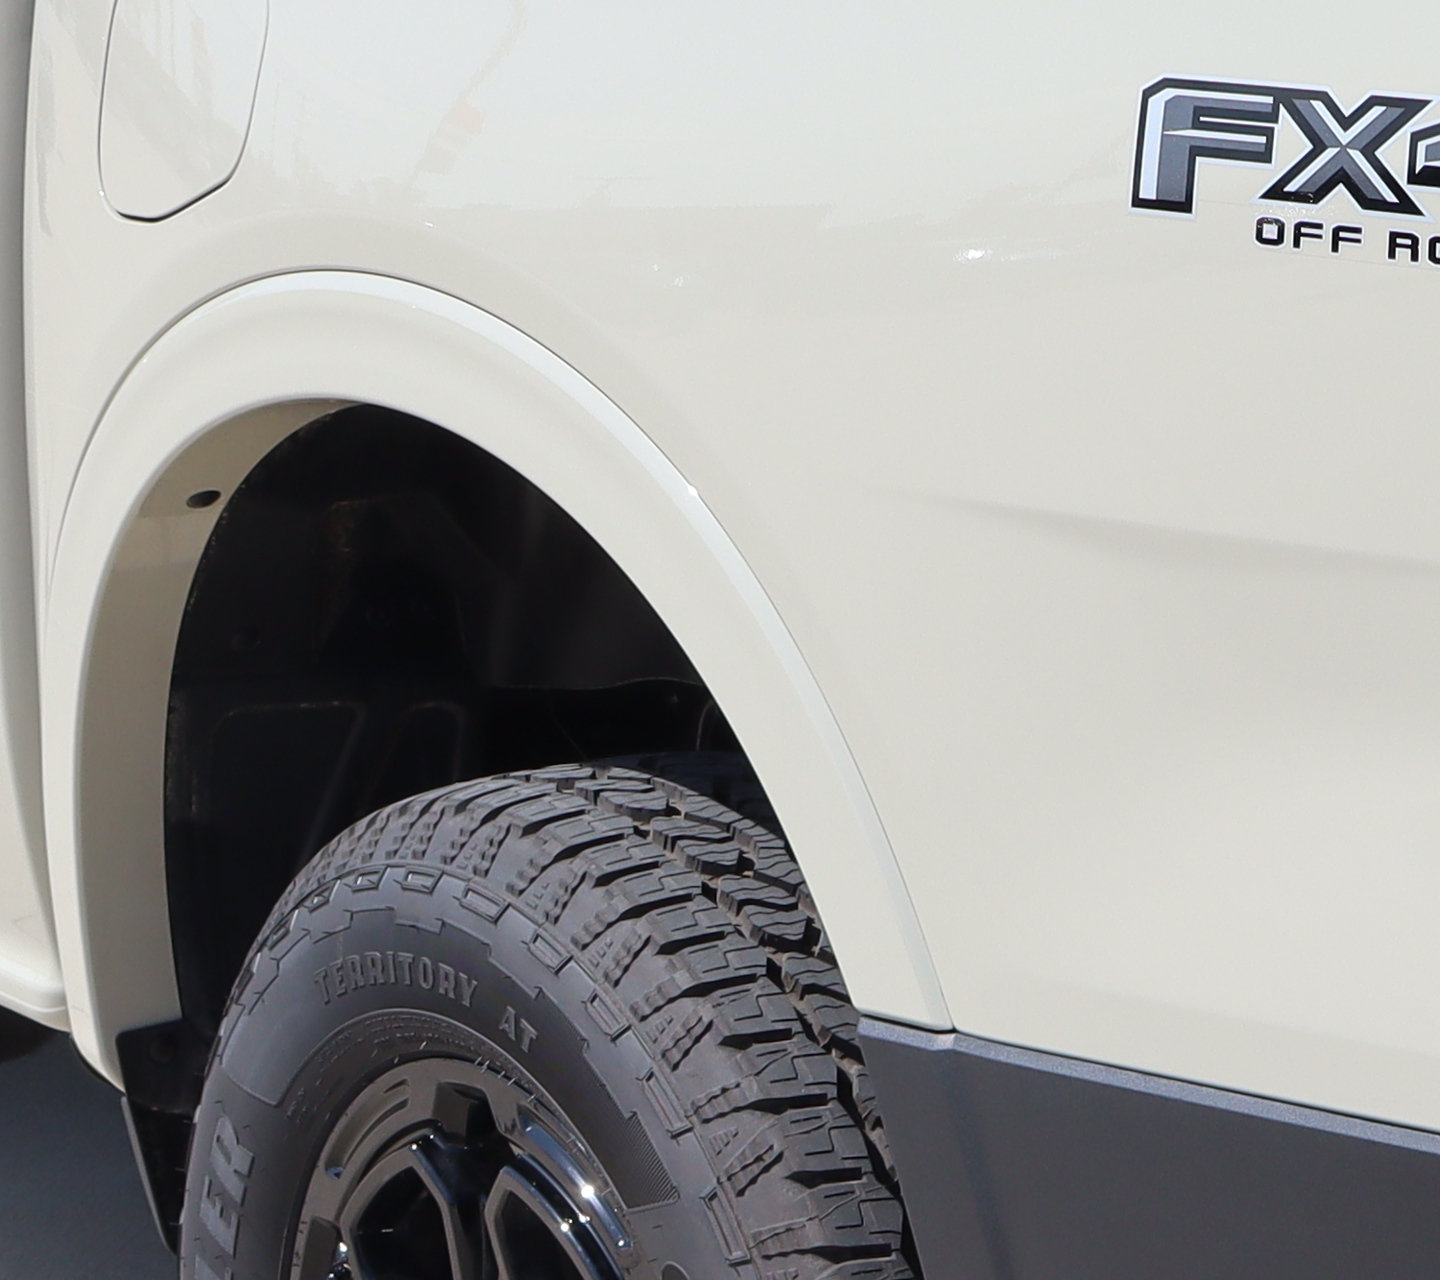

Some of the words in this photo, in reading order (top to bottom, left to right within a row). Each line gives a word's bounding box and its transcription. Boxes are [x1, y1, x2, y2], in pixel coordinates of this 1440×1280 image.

[1254, 215, 1365, 255] OFF
[313, 950, 478, 1008] TERRITORY
[498, 1005, 539, 1054] AT
